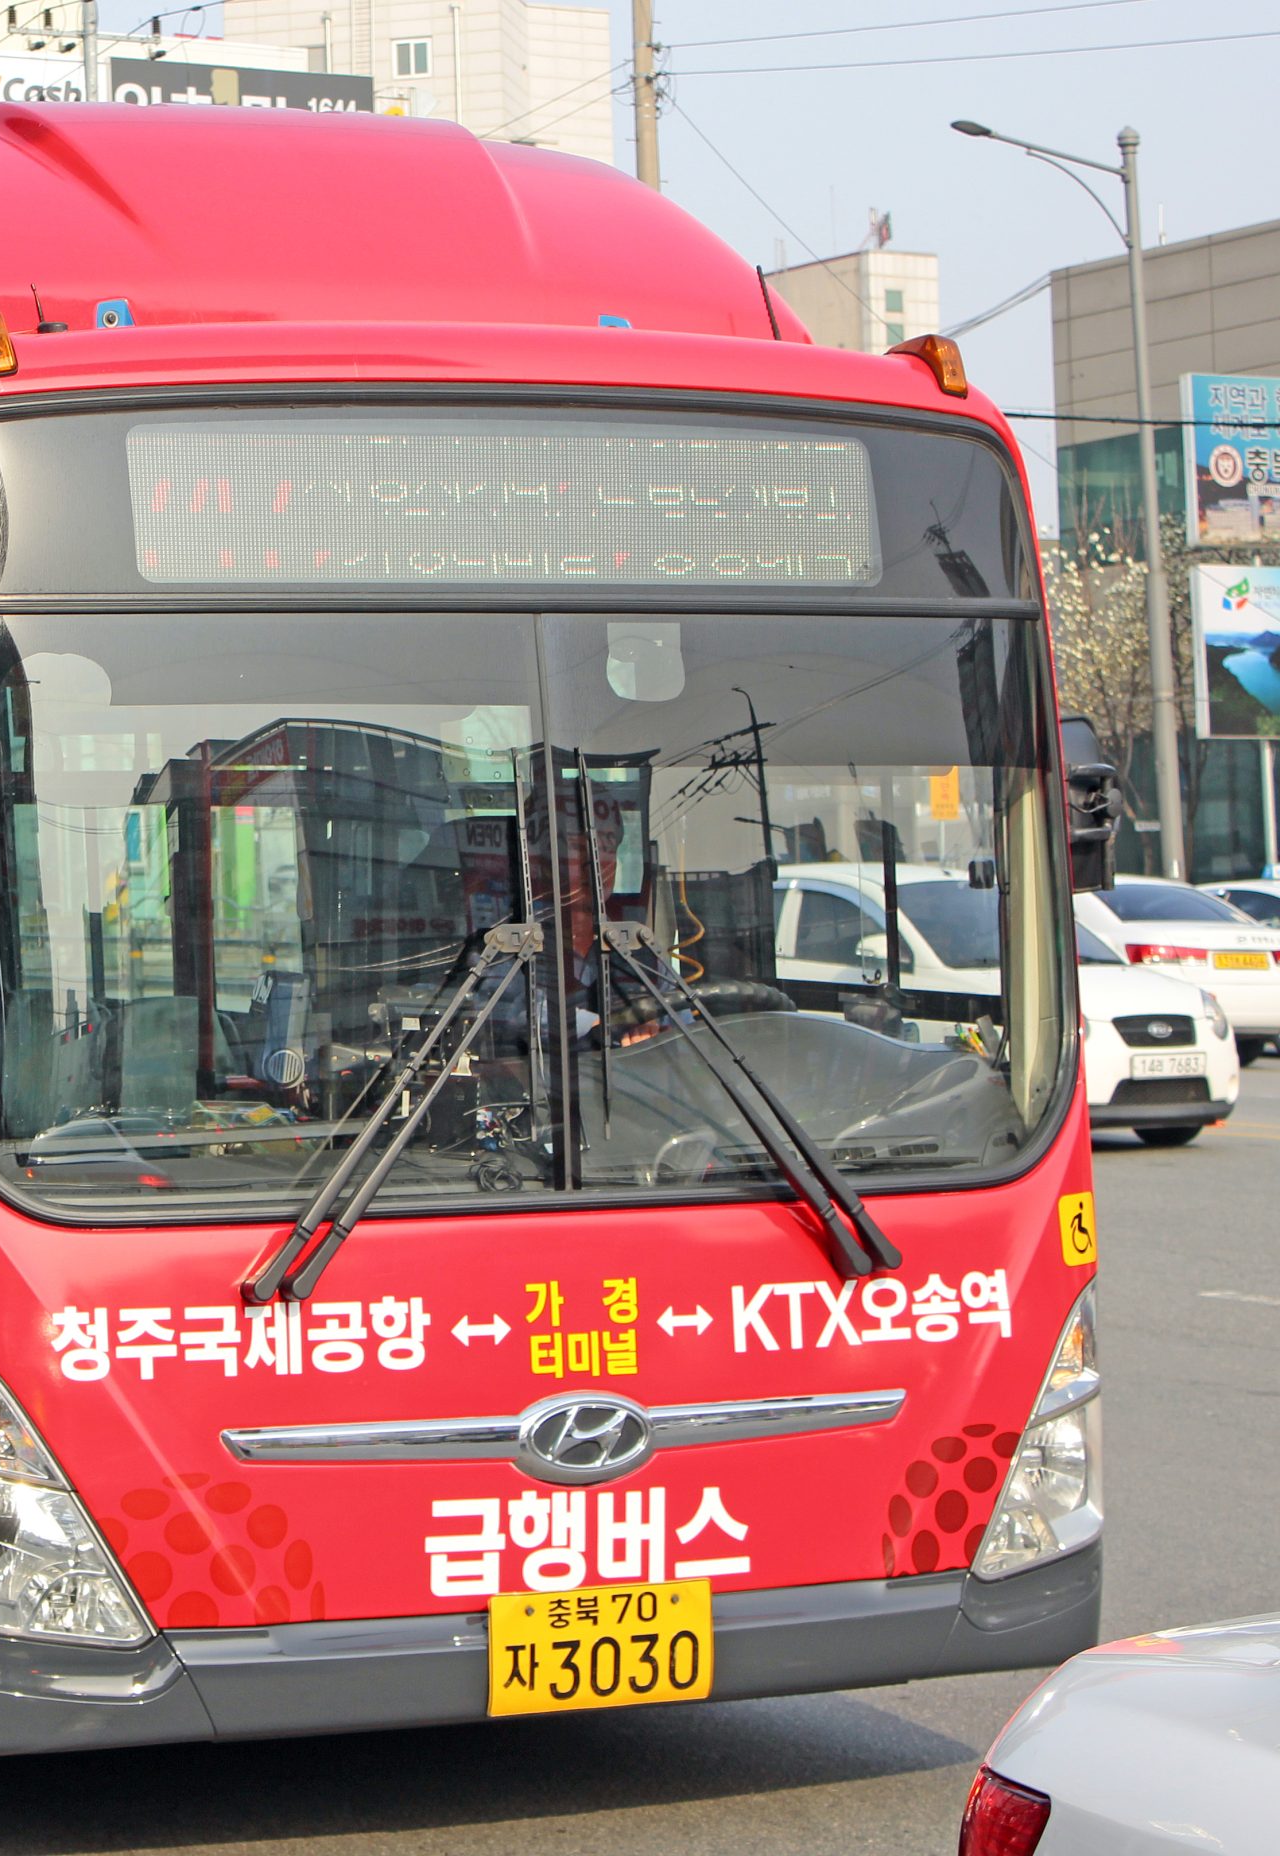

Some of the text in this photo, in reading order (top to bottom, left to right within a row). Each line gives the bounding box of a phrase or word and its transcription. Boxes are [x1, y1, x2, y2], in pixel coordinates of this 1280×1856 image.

[3, 77, 81, 103] Cash
[1210, 386, 1266, 411] 지역과
[731, 1268, 1013, 1353] KTX오송역
[50, 1296, 431, 1382] 청주국제공항
[529, 1327, 640, 1379] 터미널
[424, 1486, 751, 1597] 급행버스
[548, 1592, 658, 1629] 충북 70
